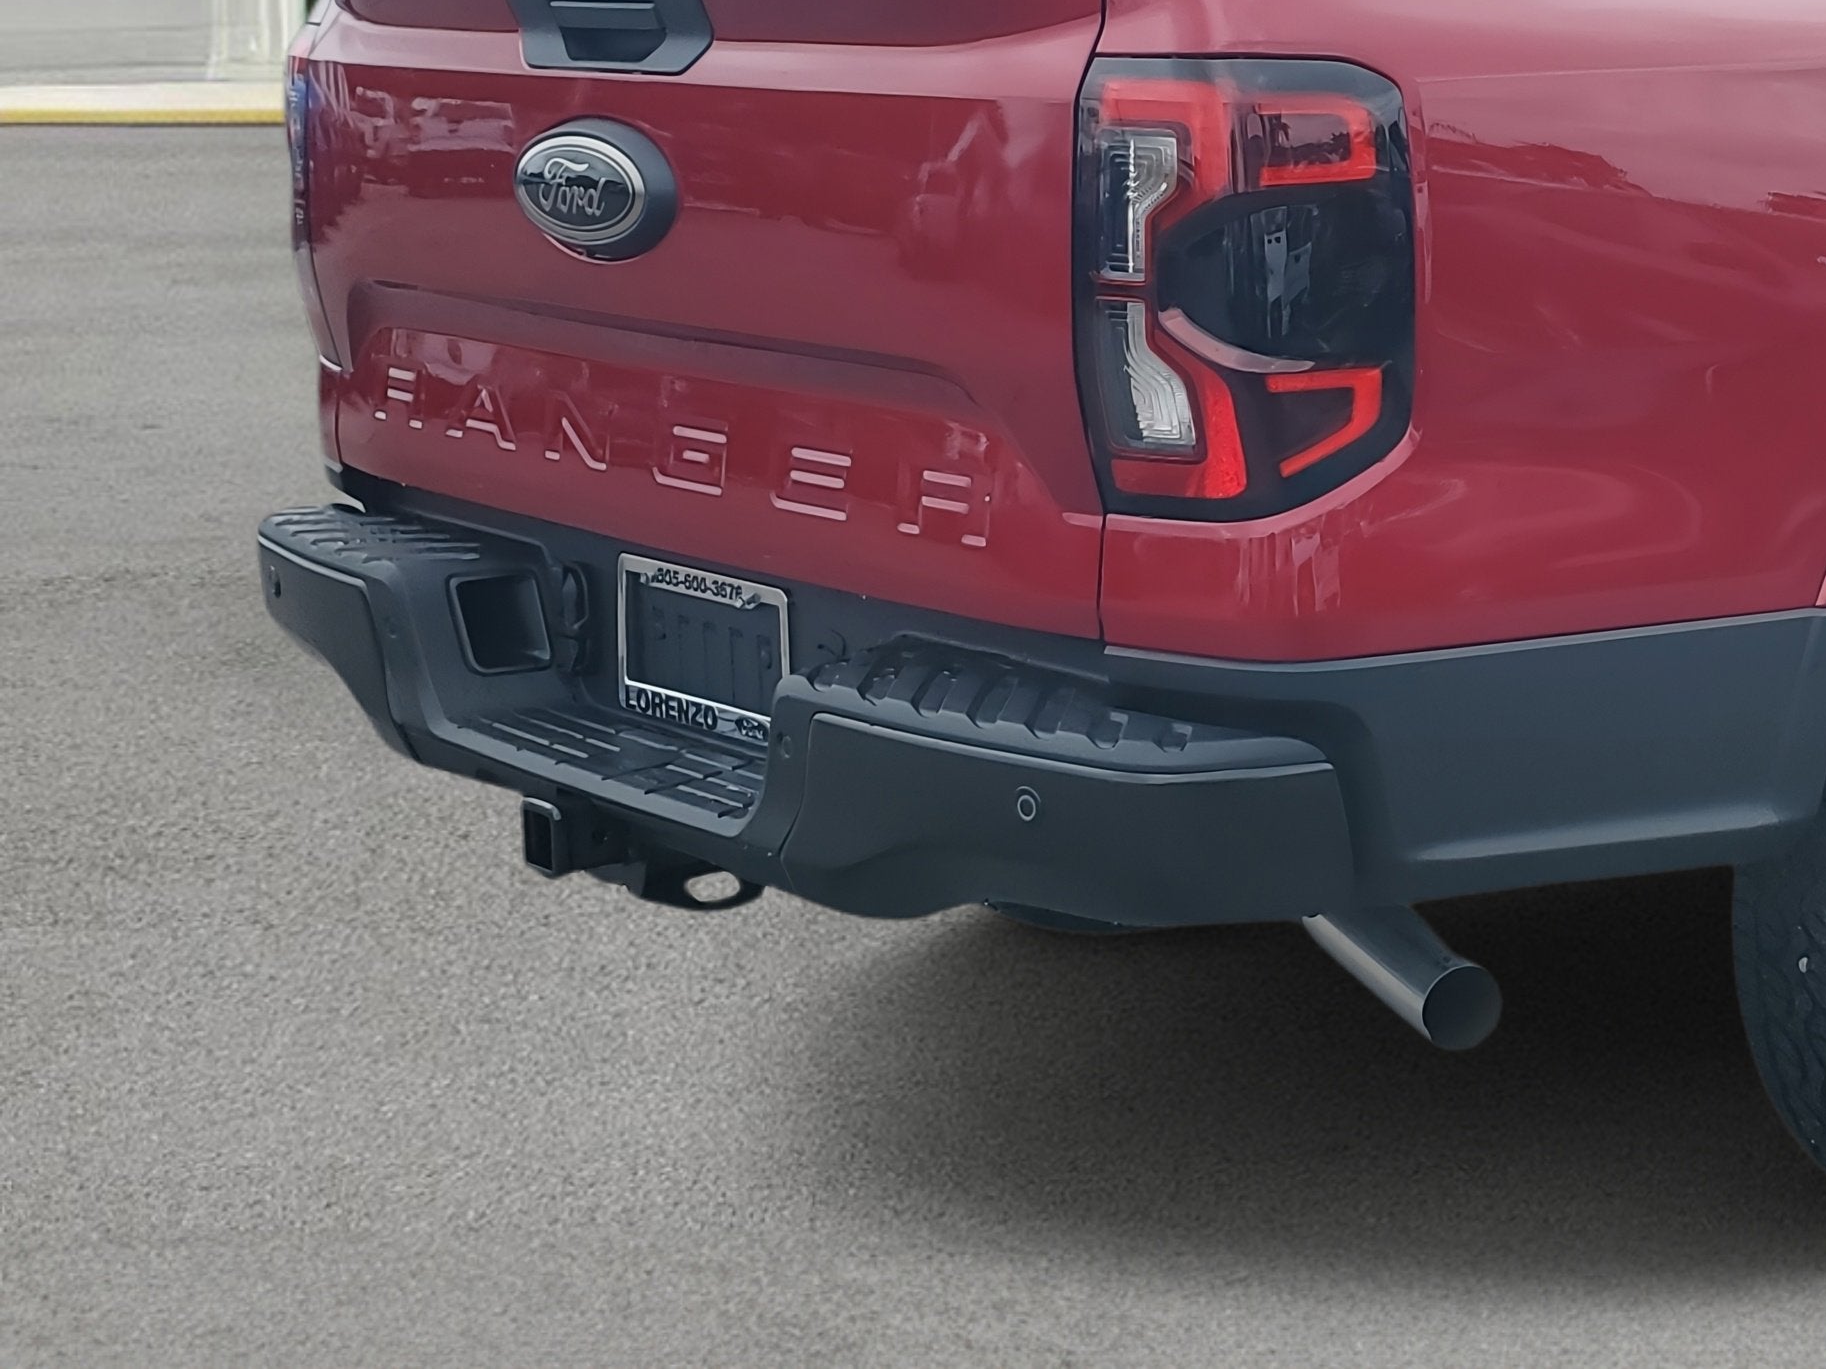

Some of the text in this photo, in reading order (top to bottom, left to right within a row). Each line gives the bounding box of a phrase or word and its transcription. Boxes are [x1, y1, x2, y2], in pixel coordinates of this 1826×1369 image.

[539, 157, 605, 217] Ford
[374, 366, 989, 548] RANGER
[625, 686, 718, 731] LORENZO
